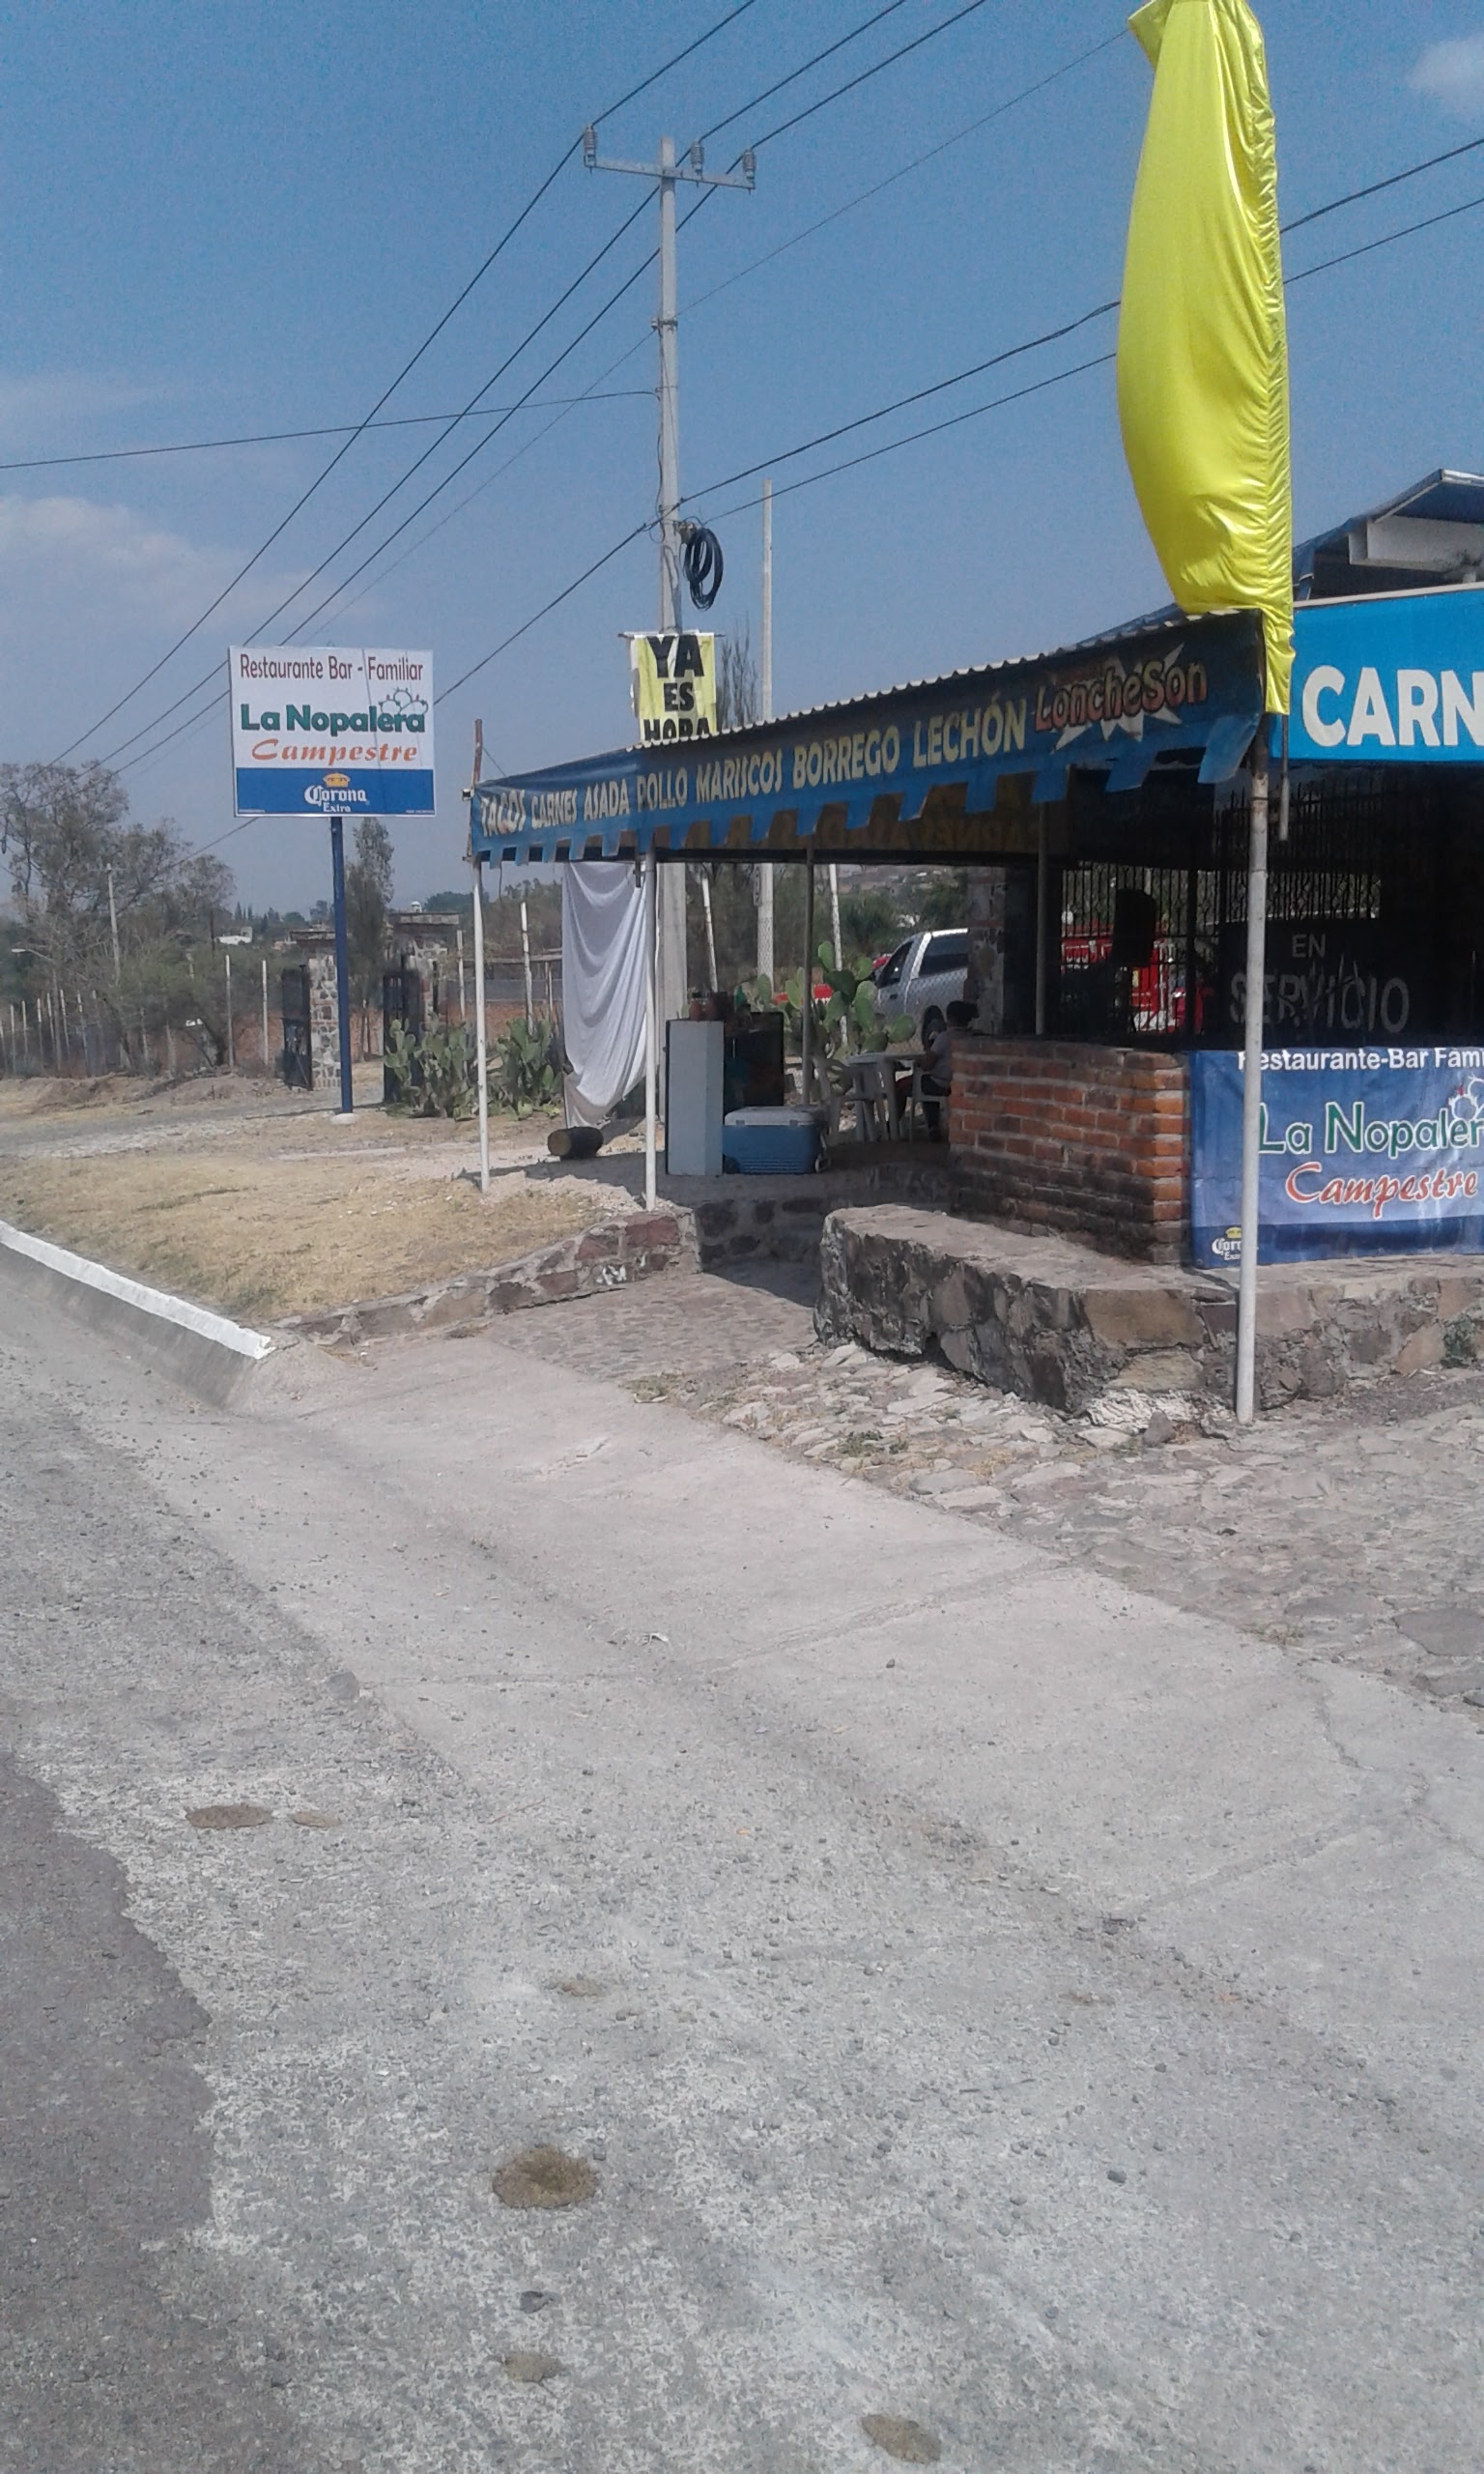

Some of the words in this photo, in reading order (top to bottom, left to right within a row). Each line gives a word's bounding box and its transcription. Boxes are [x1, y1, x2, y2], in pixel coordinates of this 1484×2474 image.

[241, 654, 324, 679] Restaurante
[328, 655, 353, 679] Bar
[367, 656, 423, 680] Familiar
[646, 635, 705, 678] YA
[664, 682, 695, 712] ES
[1301, 665, 1484, 747] CARN
[241, 704, 280, 731] La
[286, 705, 426, 736] Nopalera
[251, 738, 417, 765] Campestre
[480, 789, 528, 837] TACOS
[531, 789, 578, 830] CARNES
[584, 778, 630, 820] ASADA
[637, 766, 688, 813] POLLO
[696, 748, 783, 804] MARISCOS
[792, 725, 900, 790] BORREGO
[912, 691, 1026, 768] LECHÓN
[304, 785, 368, 806] Corona
[323, 802, 352, 813] Extra
[1292, 933, 1327, 959] EN
[1258, 1102, 1311, 1155] La
[1285, 1162, 1478, 1221] Campestre
